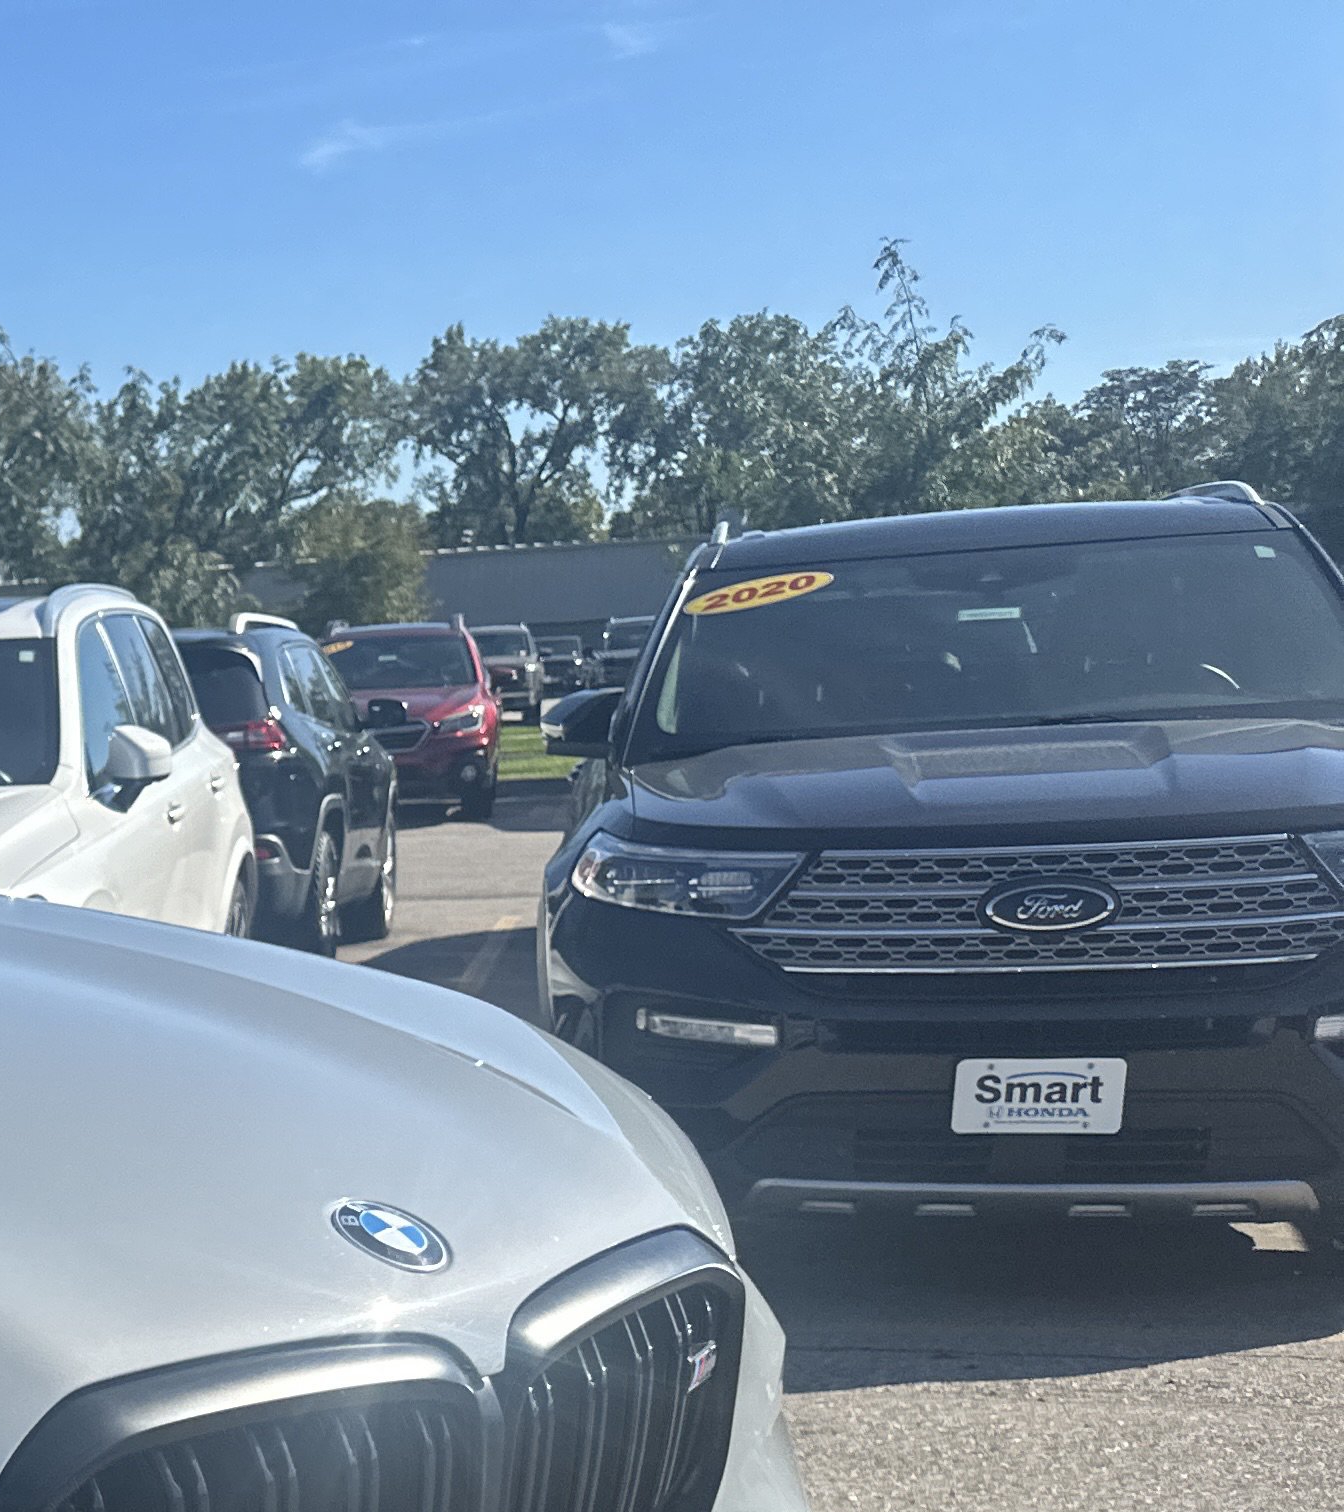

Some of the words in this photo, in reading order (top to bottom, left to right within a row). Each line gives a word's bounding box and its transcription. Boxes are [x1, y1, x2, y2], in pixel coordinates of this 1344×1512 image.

[703, 575, 815, 611] 2020
[1016, 893, 1084, 920] Ford
[974, 1073, 1105, 1104] Smart
[1007, 1107, 1090, 1118] HONDA
